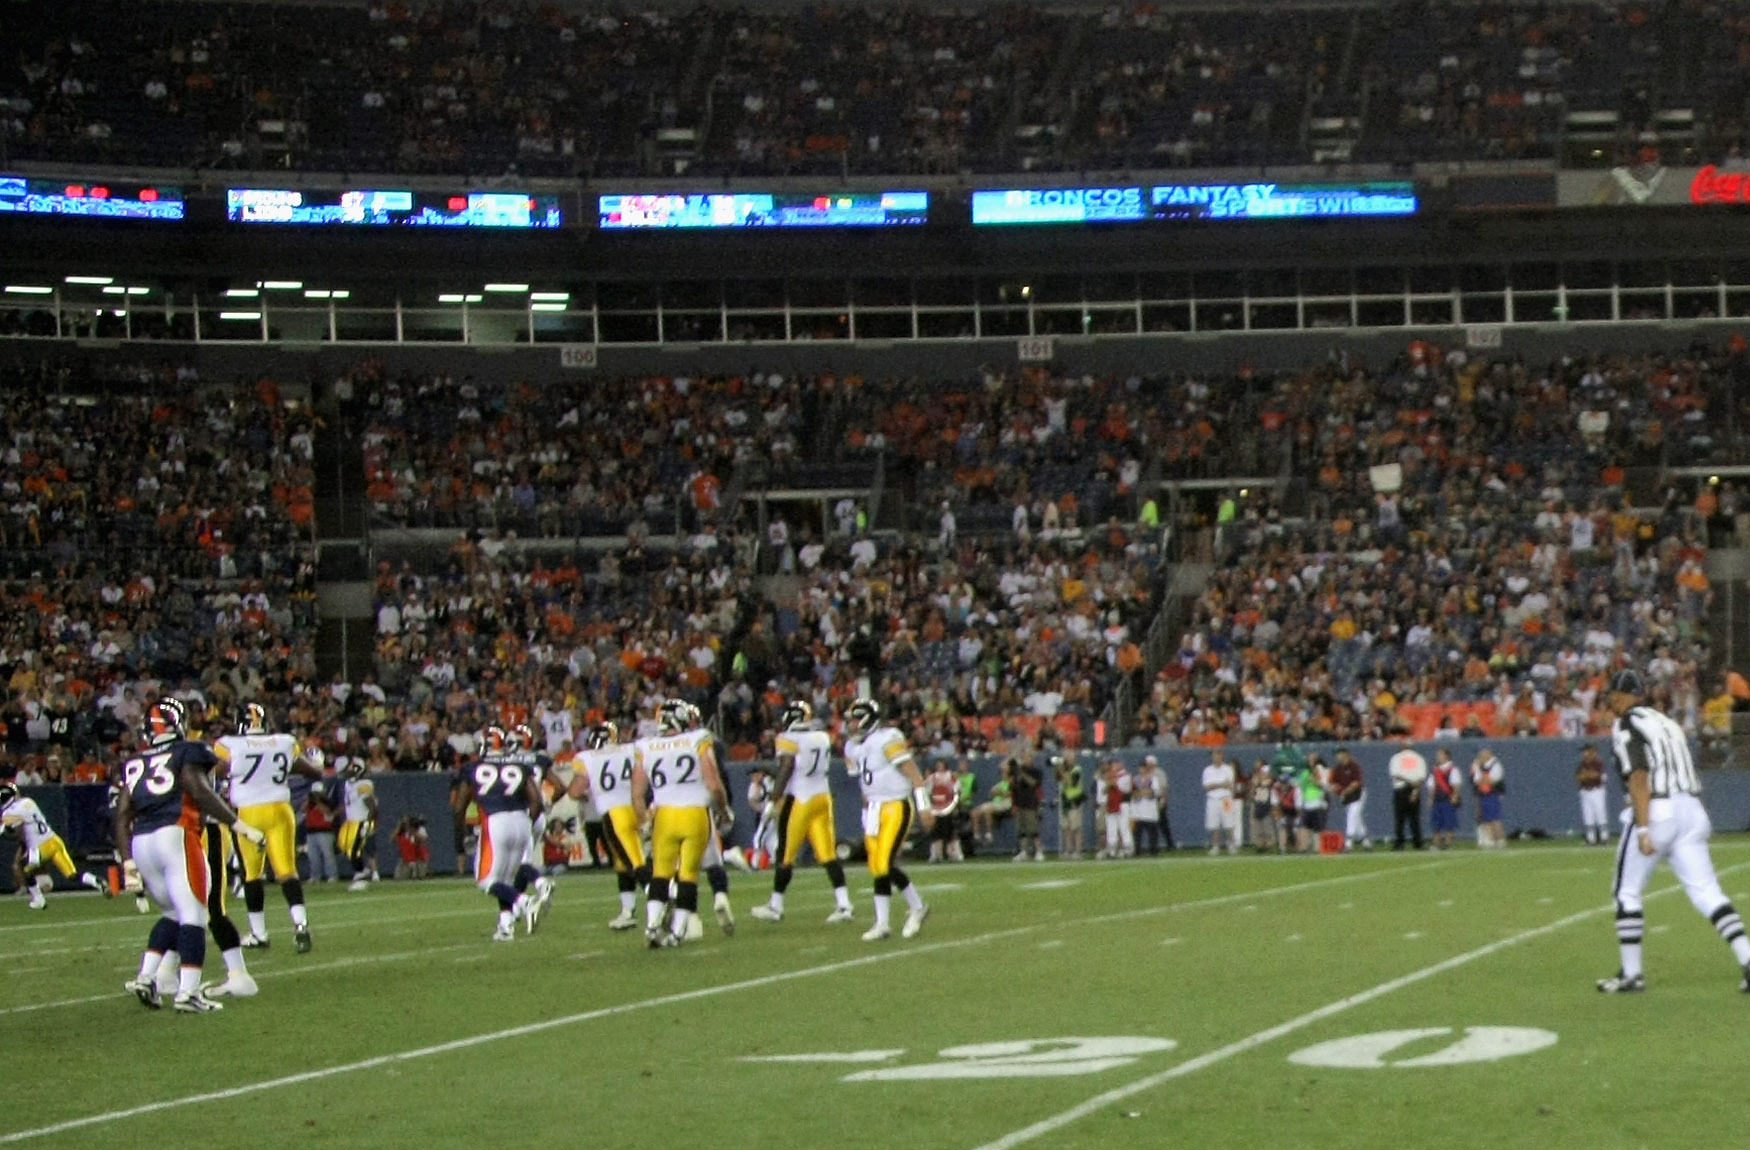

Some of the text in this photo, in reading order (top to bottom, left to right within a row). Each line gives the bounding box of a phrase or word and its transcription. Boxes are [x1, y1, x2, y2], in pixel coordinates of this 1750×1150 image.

[1005, 184, 1277, 206] BRONCOS FANTASY
[124, 752, 175, 796] 93
[240, 752, 289, 785] 73
[474, 763, 524, 797] 99
[651, 754, 696, 789] 62
